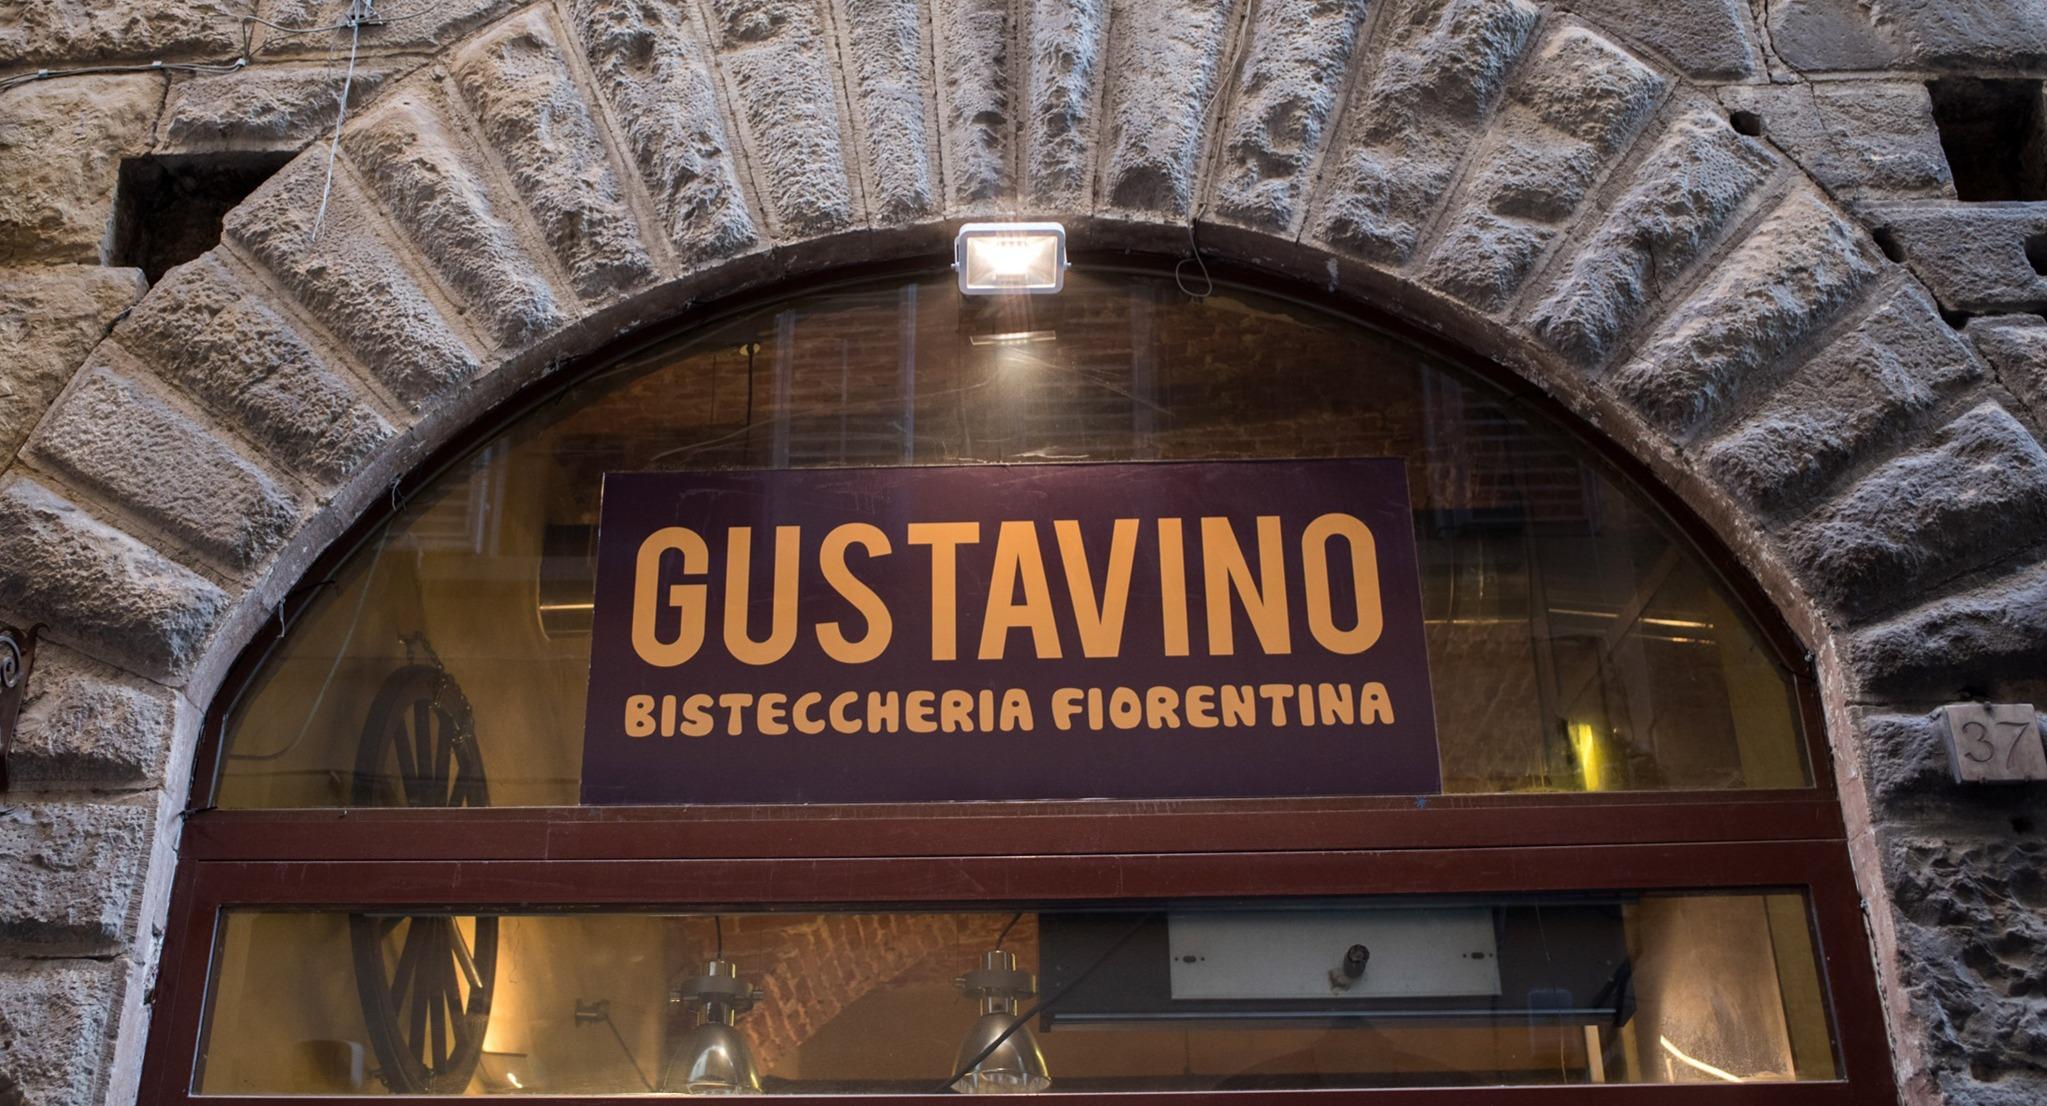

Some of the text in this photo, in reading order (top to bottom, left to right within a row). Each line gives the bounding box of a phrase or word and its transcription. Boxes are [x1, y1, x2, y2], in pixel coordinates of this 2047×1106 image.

[631, 513, 1383, 667] GUSTAVINO
[624, 682, 1395, 737] BISTECCHERIA FIORENTINA
[1961, 720, 2030, 770] 37
